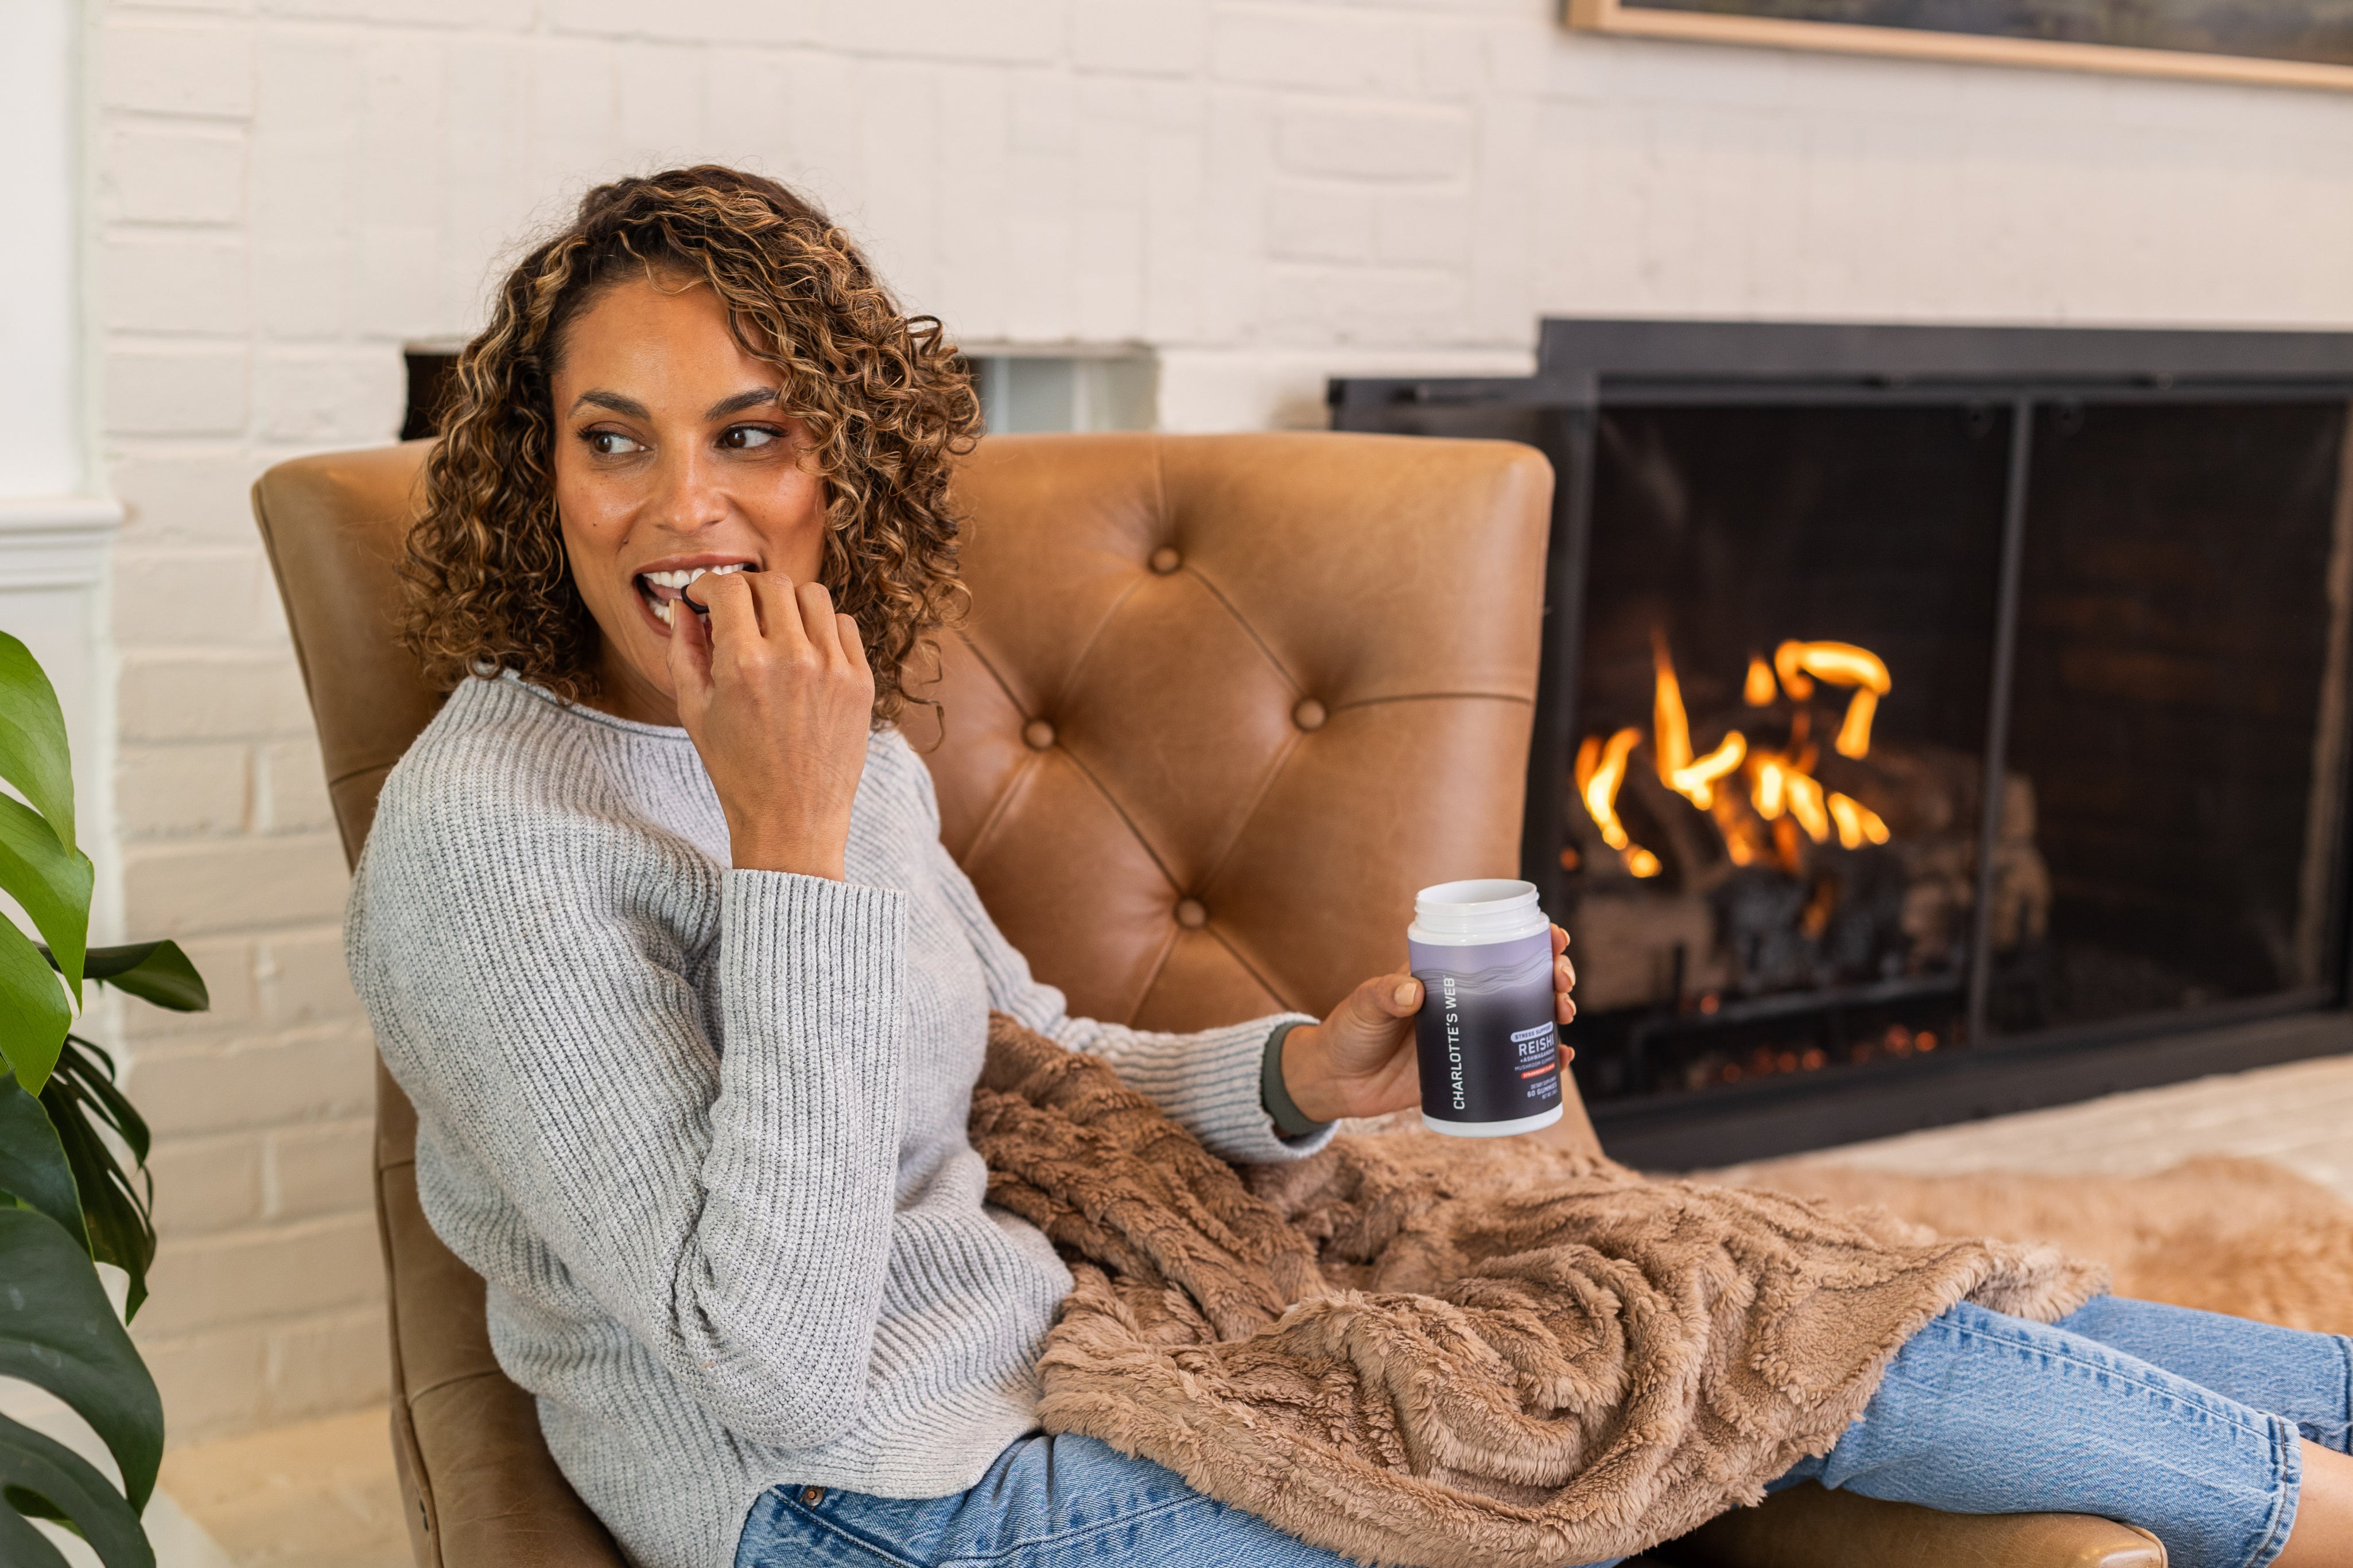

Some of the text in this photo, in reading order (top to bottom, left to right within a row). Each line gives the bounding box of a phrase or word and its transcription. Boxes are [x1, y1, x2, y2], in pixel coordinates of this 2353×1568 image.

[1515, 1030, 1535, 1040] STRESS
[1443, 977, 1465, 1110] CHARLOTTE'S WEB
[1519, 1033, 1554, 1056] REISHI
[1527, 1090, 1536, 1098] 60
